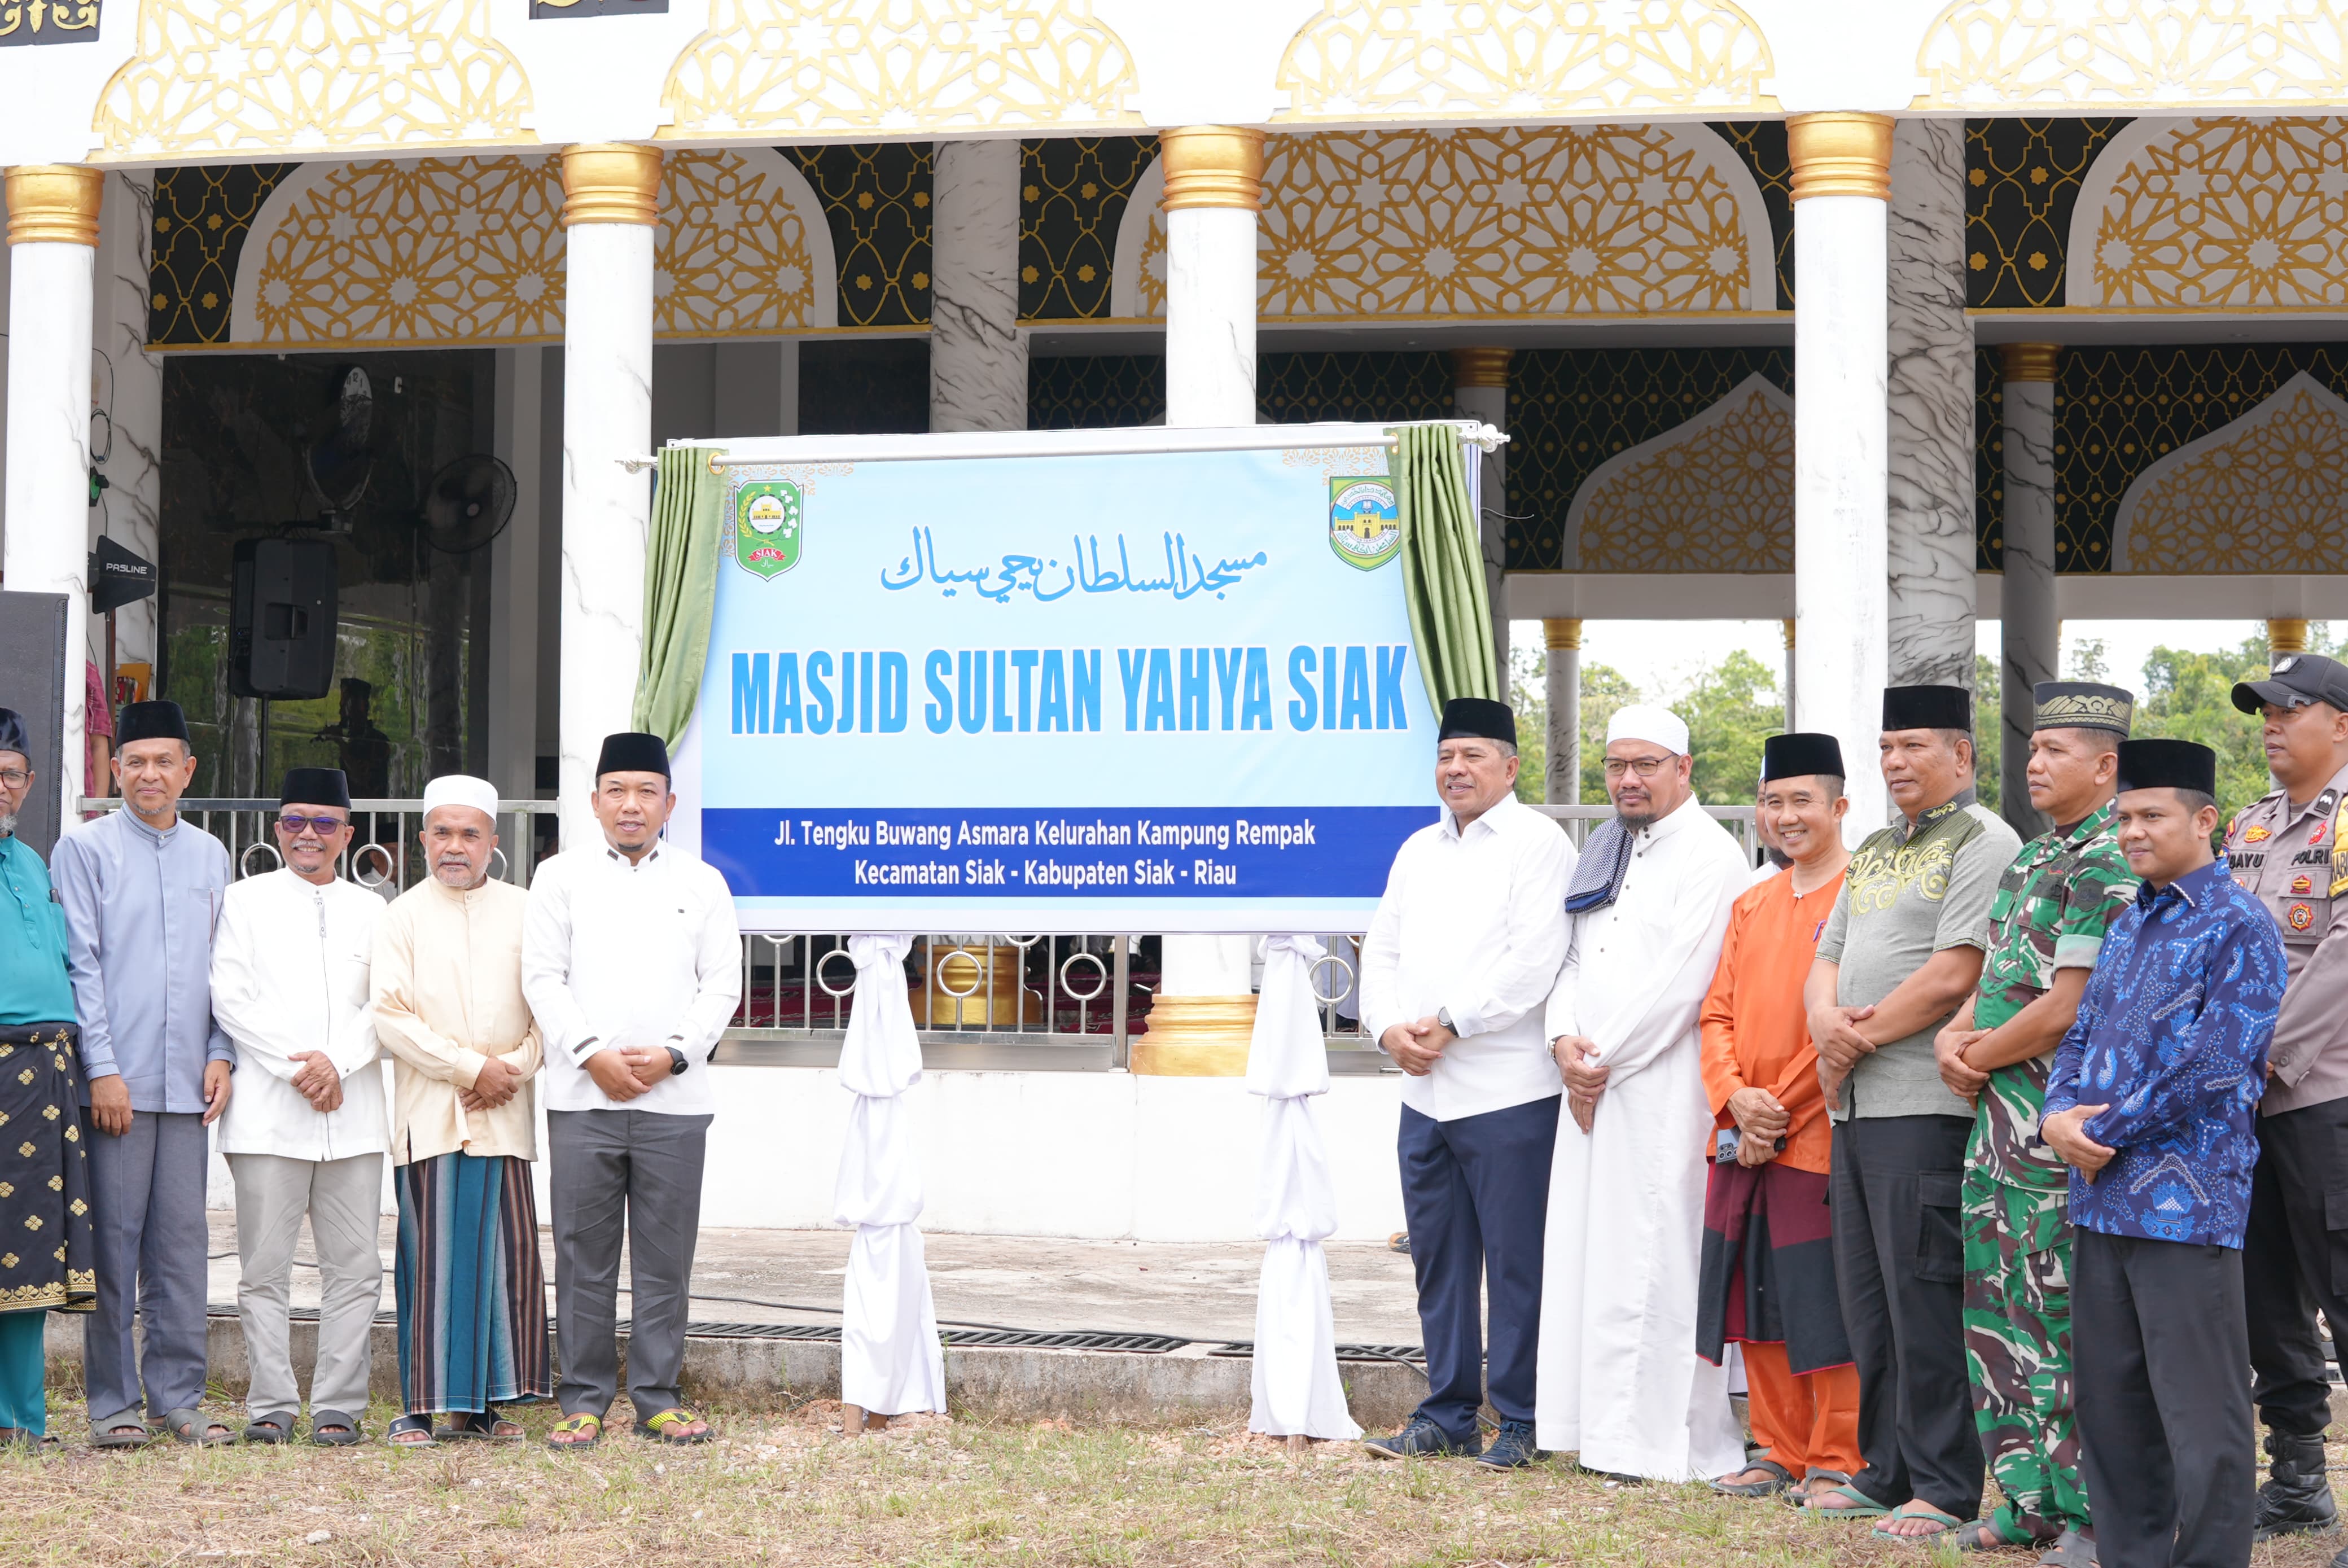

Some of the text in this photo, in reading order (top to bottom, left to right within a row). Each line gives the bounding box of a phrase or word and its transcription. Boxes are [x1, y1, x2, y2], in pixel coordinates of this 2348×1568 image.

[106, 563, 148, 575] PASLINE
[756, 549, 777, 558] SIAK
[1033, 532, 1188, 602] السلطان
[1173, 551, 1267, 600] مسجد
[732, 645, 1408, 735] MASJID SULTAN YAHYA SIAK
[774, 819, 1316, 850] Jl. Tengku Buwang Asmara Kelurahan Kampung Rempak
[2229, 852, 2264, 870] BAYU
[2291, 848, 2330, 866] POLRI
[855, 860, 960, 884] Kecamatan
[965, 859, 1006, 885] Siak
[1024, 859, 1128, 890] Kabupaten
[1134, 859, 1175, 885] Siak
[1194, 860, 1236, 884] Riau
